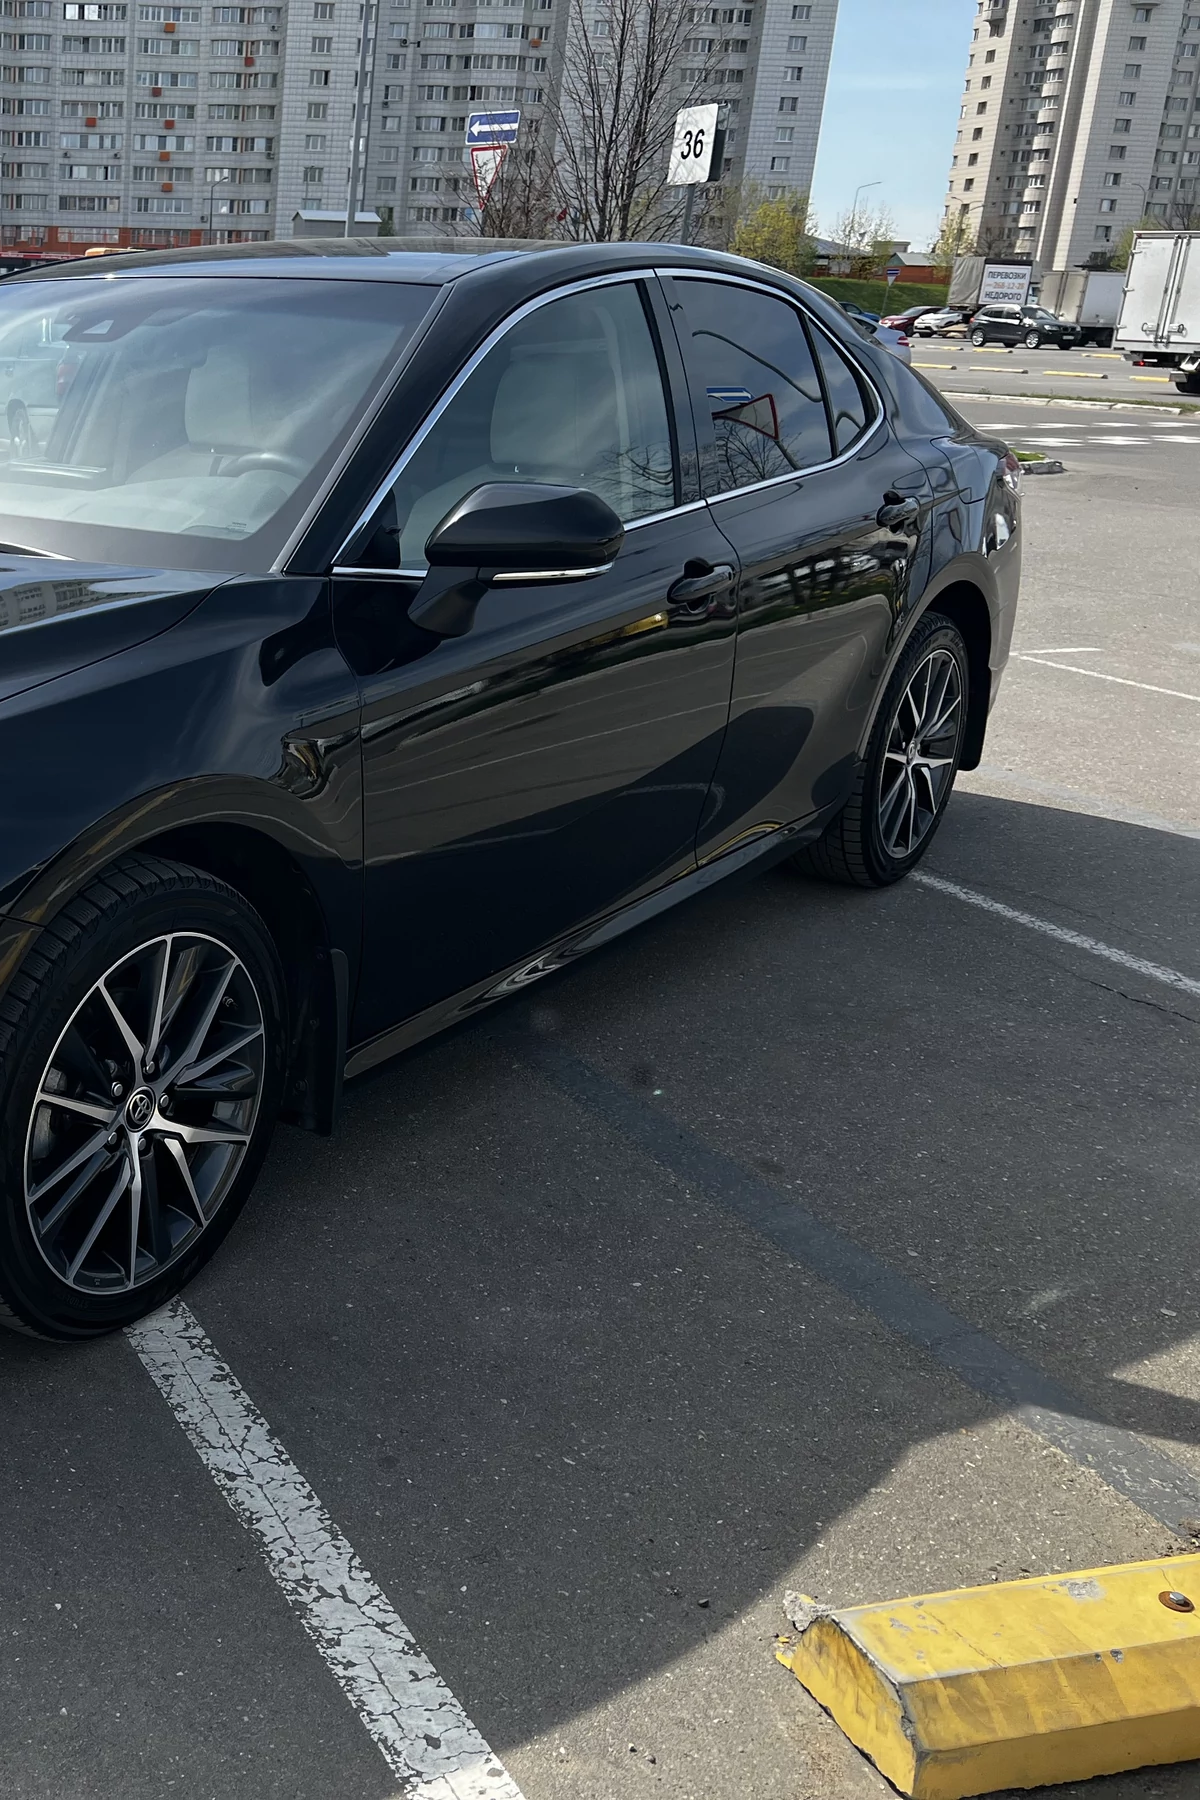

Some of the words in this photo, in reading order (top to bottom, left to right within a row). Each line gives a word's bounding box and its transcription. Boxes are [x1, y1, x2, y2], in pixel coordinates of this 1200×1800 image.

[681, 128, 705, 160] 36
[987, 271, 1027, 280] ПЕРЕВОЗКИ
[984, 291, 1022, 301] НЕДОРОГО
